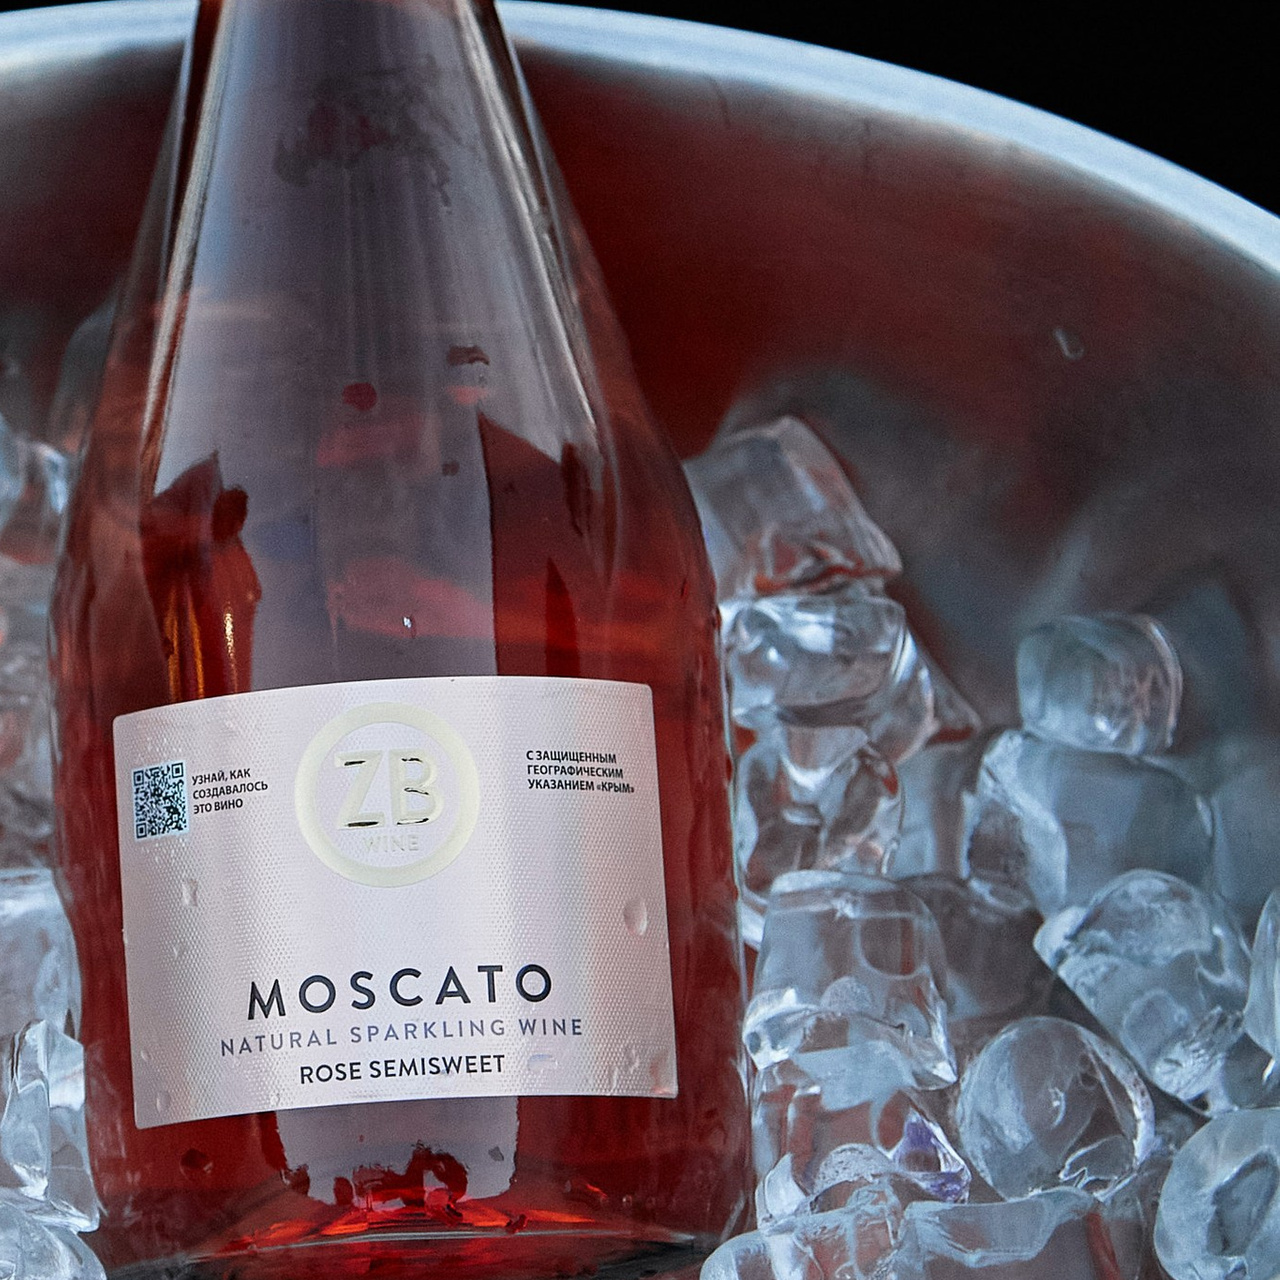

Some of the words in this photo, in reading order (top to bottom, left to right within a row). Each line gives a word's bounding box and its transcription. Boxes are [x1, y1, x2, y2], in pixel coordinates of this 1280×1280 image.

[526, 750, 534, 761] С
[536, 750, 617, 764] ЗАЩИЩЕННЫМ
[191, 770, 228, 786] УЗНАЙ,
[229, 768, 251, 780] КАК
[527, 764, 624, 779] ГЕОГРАФИЧЕСКИМ
[192, 781, 268, 799] СОЗДАВАЛОСЬ
[334, 749, 444, 831] ZB
[527, 779, 595, 791] УКАЗАНИЕМ
[596, 781, 635, 793] «КРЫМ»
[193, 803, 212, 815] ЭТО
[214, 799, 243, 811] ВИНО
[363, 834, 420, 853] WINE
[247, 964, 552, 1021] MOSCATO
[220, 1028, 337, 1057] NATURAL
[350, 1019, 506, 1044] SPARKLING
[519, 1018, 583, 1037] WINE
[300, 1062, 362, 1085] ROSE
[369, 1054, 505, 1079] SEMISWEET
